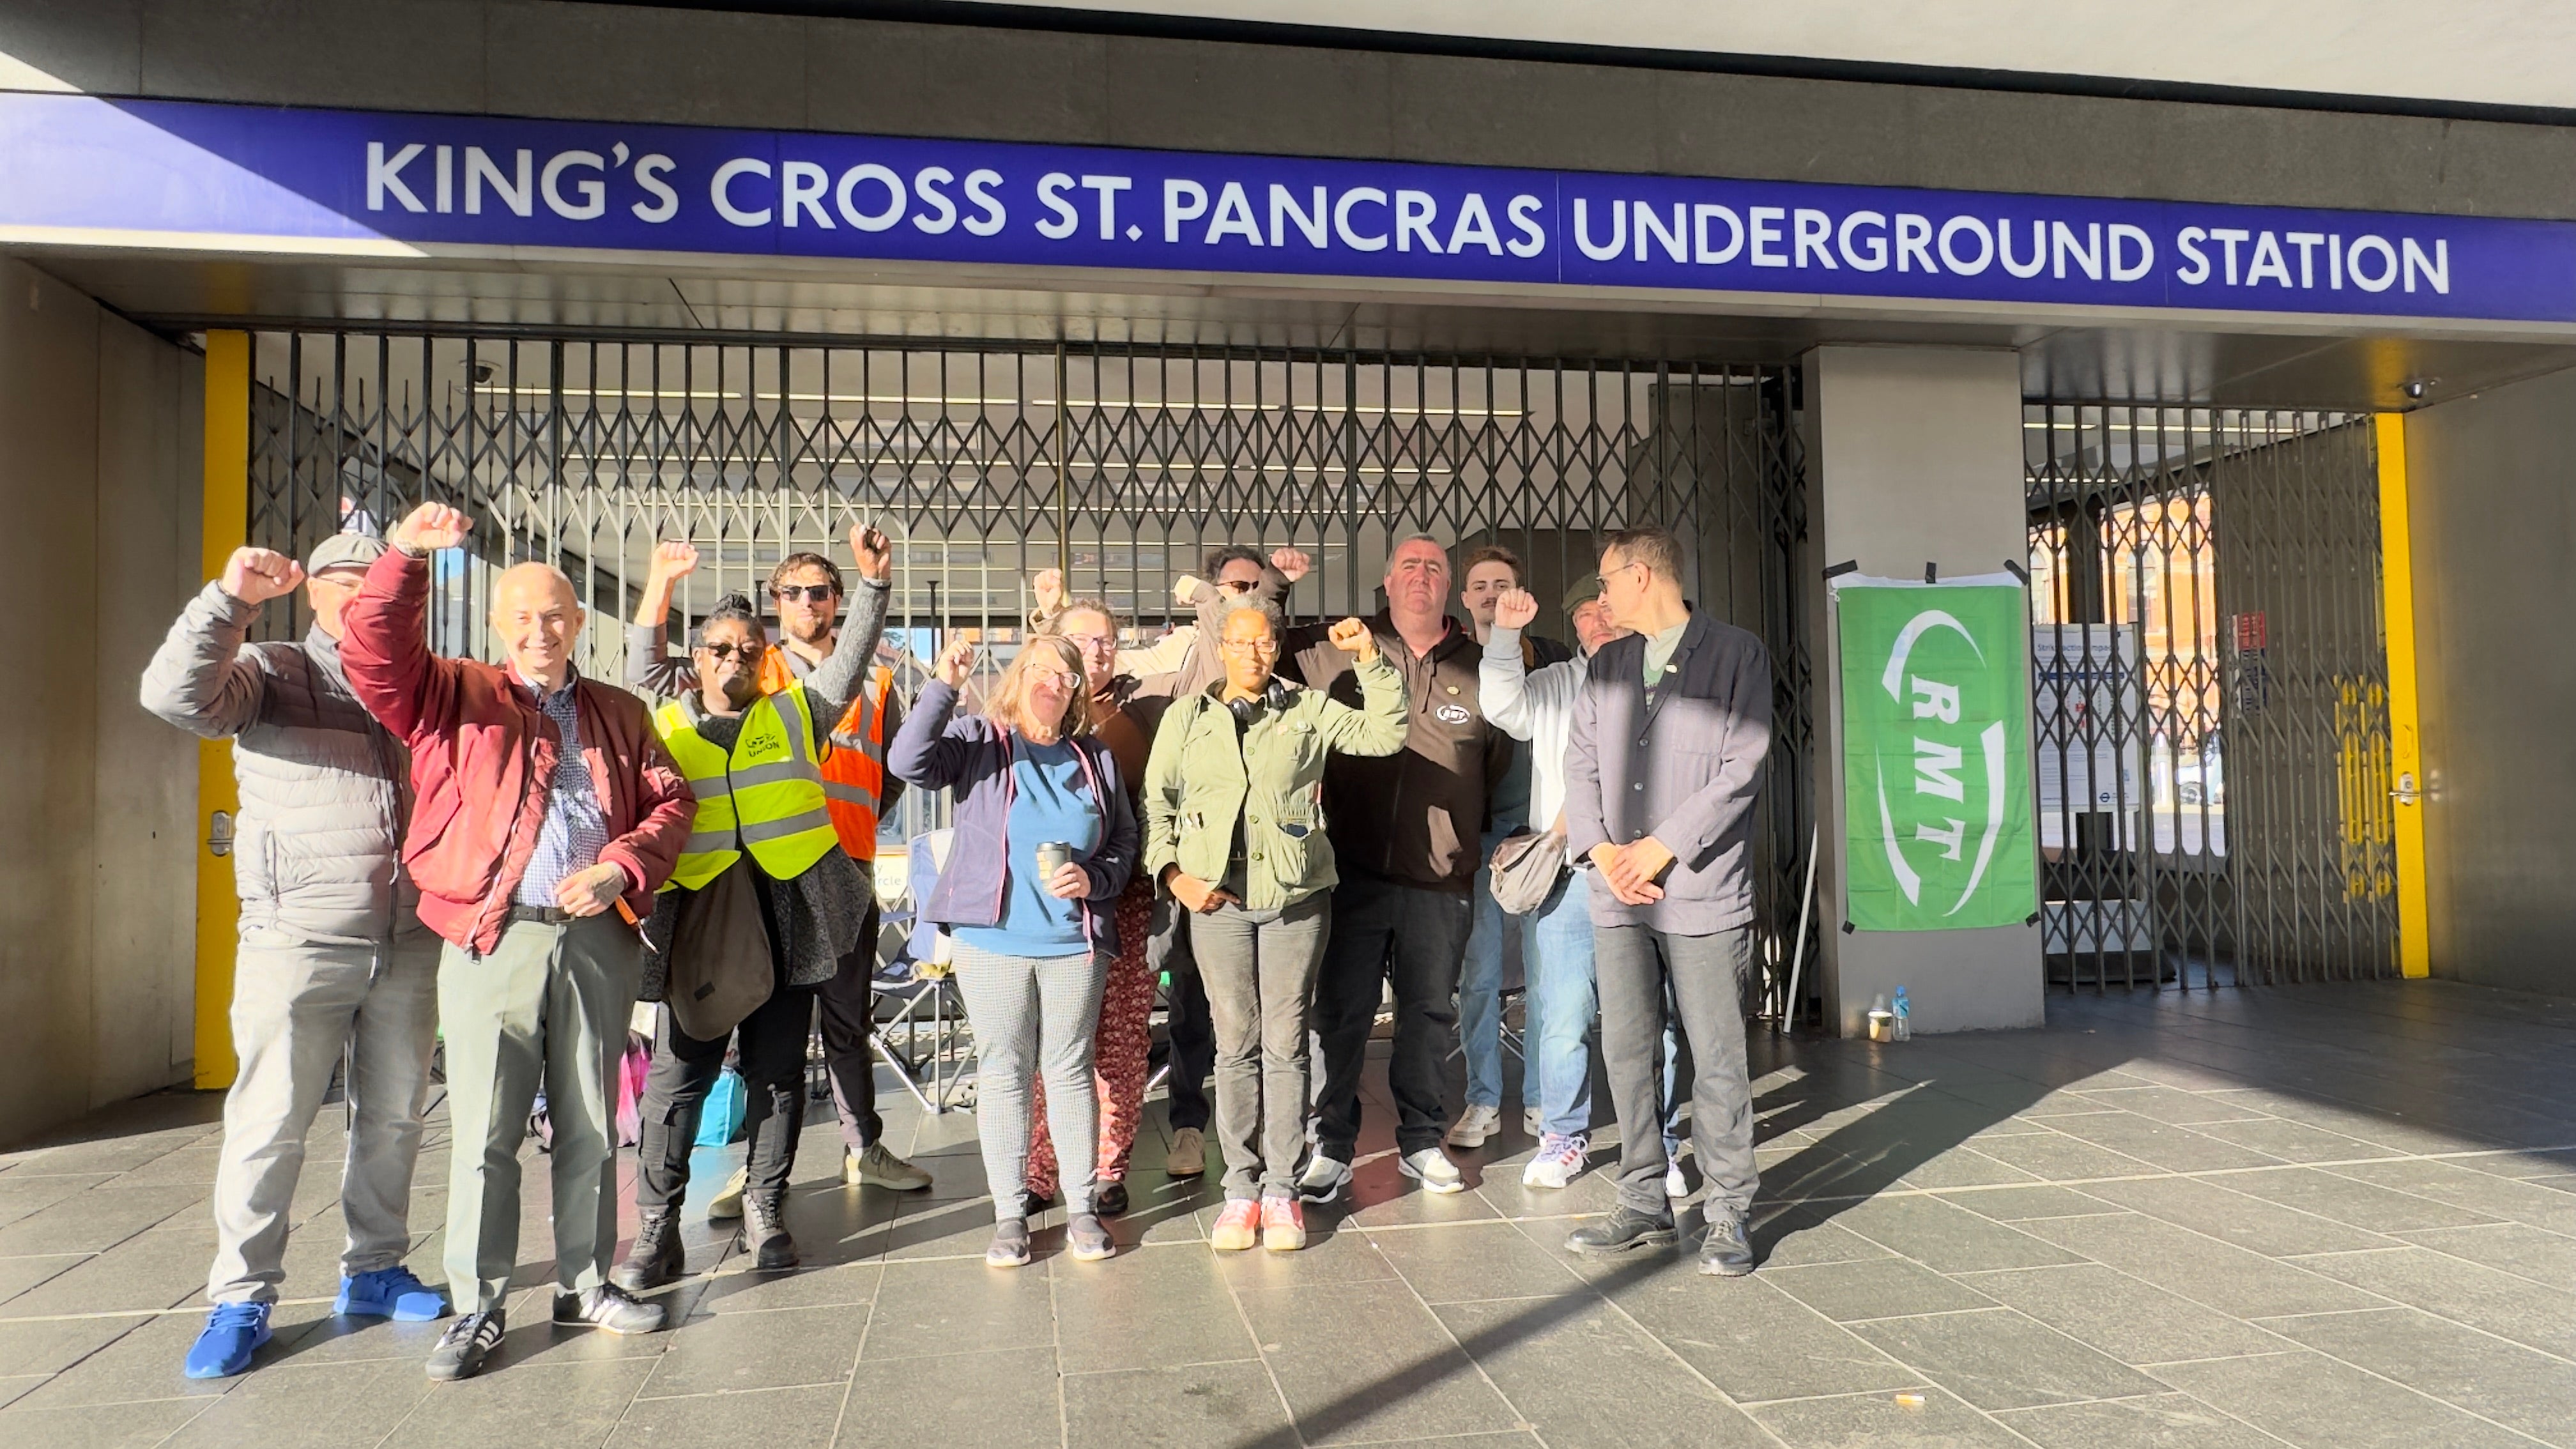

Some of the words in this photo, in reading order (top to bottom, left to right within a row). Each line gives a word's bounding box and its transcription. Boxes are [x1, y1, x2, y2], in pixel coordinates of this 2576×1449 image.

[367, 142, 678, 222] KING'S
[710, 158, 1007, 236] CROSS
[1034, 172, 1142, 241] ST.
[1164, 179, 1545, 258] PANCRAS
[1574, 198, 2154, 281] UNDERGROUND
[2176, 226, 2450, 294] STATION
[1911, 673, 1966, 861] RMT
